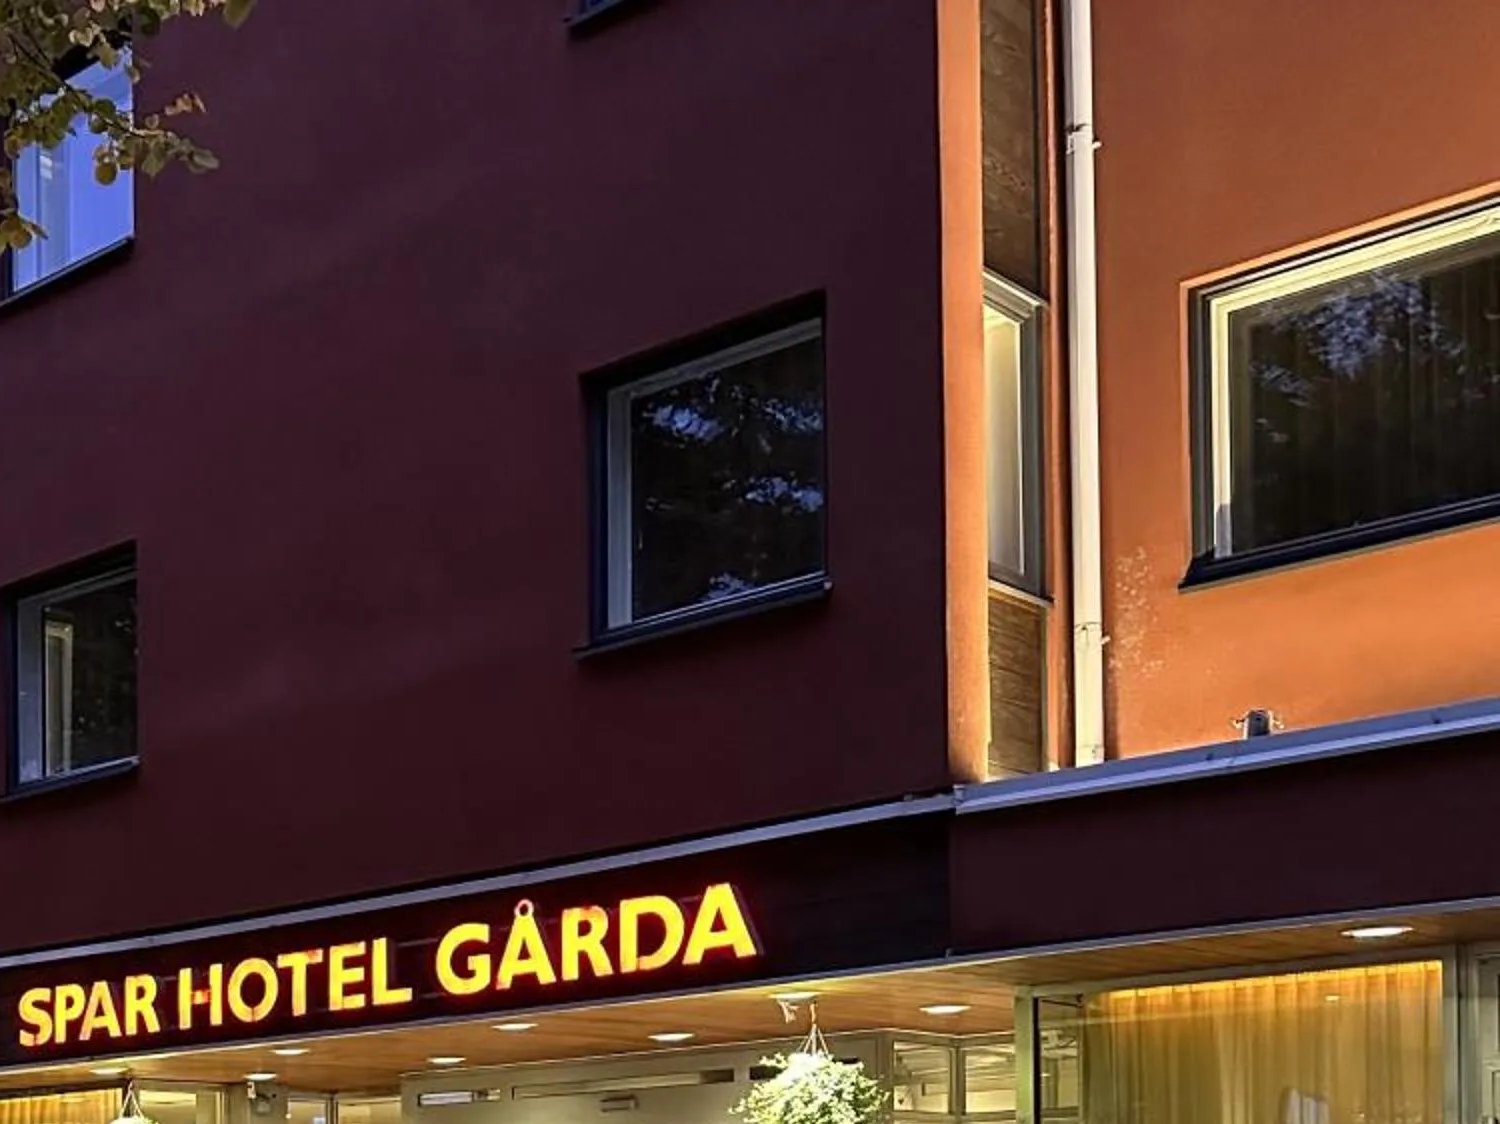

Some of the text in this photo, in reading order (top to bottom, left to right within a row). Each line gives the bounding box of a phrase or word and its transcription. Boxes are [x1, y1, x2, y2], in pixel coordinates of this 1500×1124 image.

[18, 883, 757, 1047] SPAR HOTEL GÅRDA
